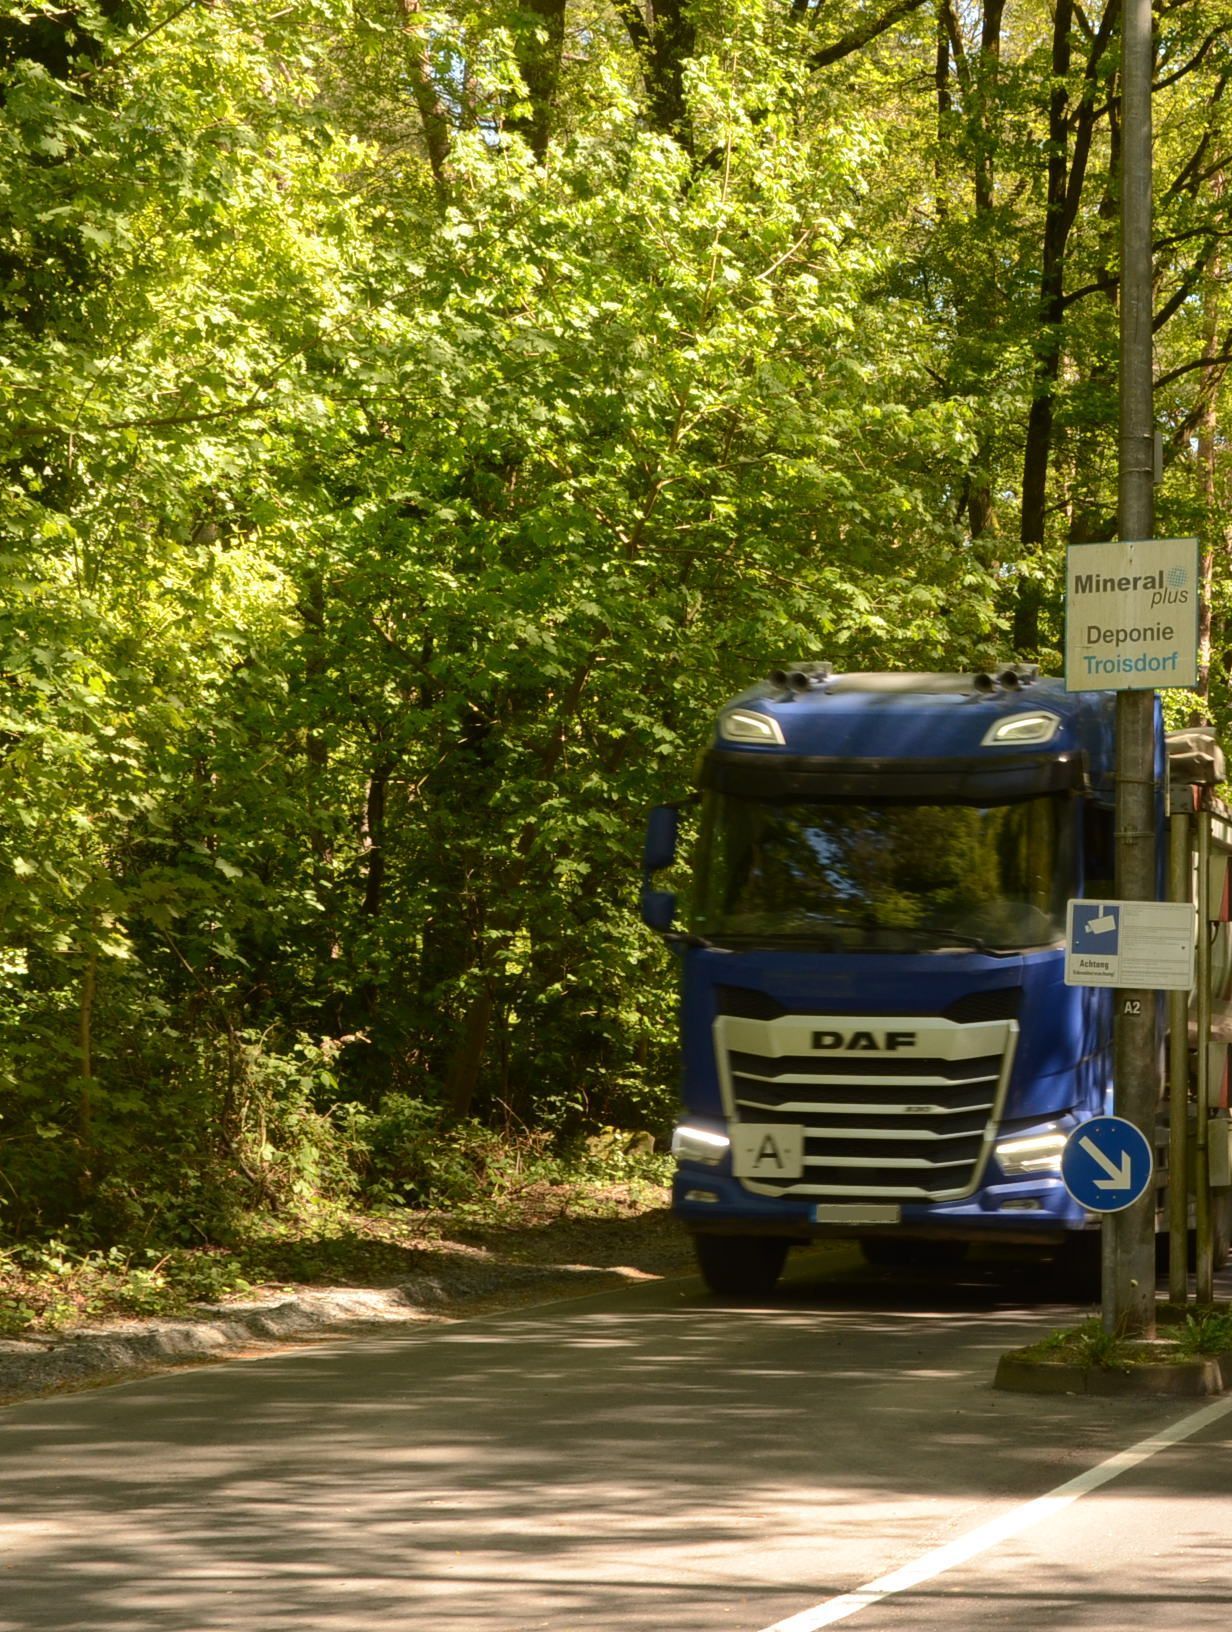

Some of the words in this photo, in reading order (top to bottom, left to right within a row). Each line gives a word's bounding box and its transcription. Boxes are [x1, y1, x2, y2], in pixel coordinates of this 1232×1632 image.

[1074, 570, 1164, 595] Mineral
[1150, 587, 1189, 609] plus
[1087, 622, 1174, 648] Deponie
[1083, 651, 1179, 674] Troisdorf
[1080, 959, 1109, 970] Achtung
[1124, 1001, 1141, 1014] A2
[811, 1031, 916, 1050] DAF
